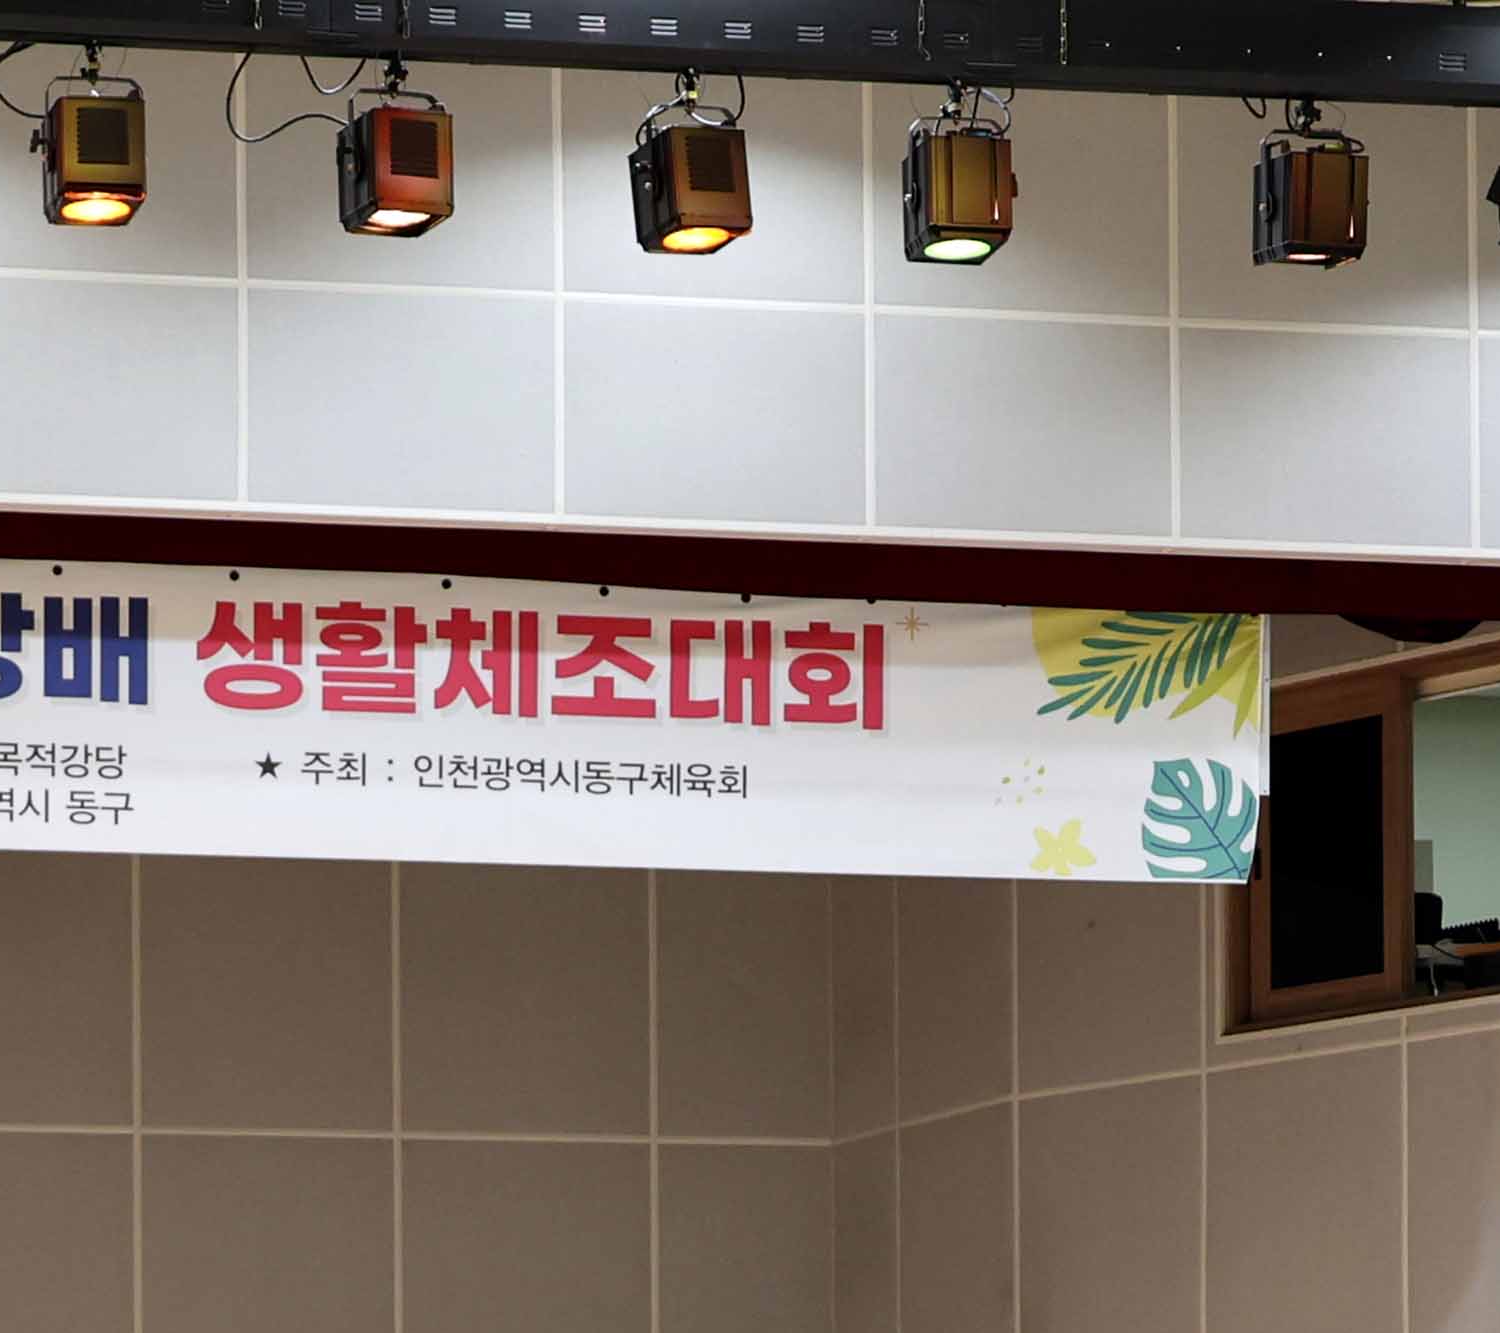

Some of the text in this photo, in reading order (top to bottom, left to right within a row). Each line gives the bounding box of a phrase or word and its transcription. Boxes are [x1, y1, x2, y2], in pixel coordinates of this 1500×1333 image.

[197, 601, 885, 730] 생활체조대회
[301, 752, 366, 786] 주최
[414, 755, 747, 799] 인천광역시동구체육회
[66, 791, 133, 826] 동구
